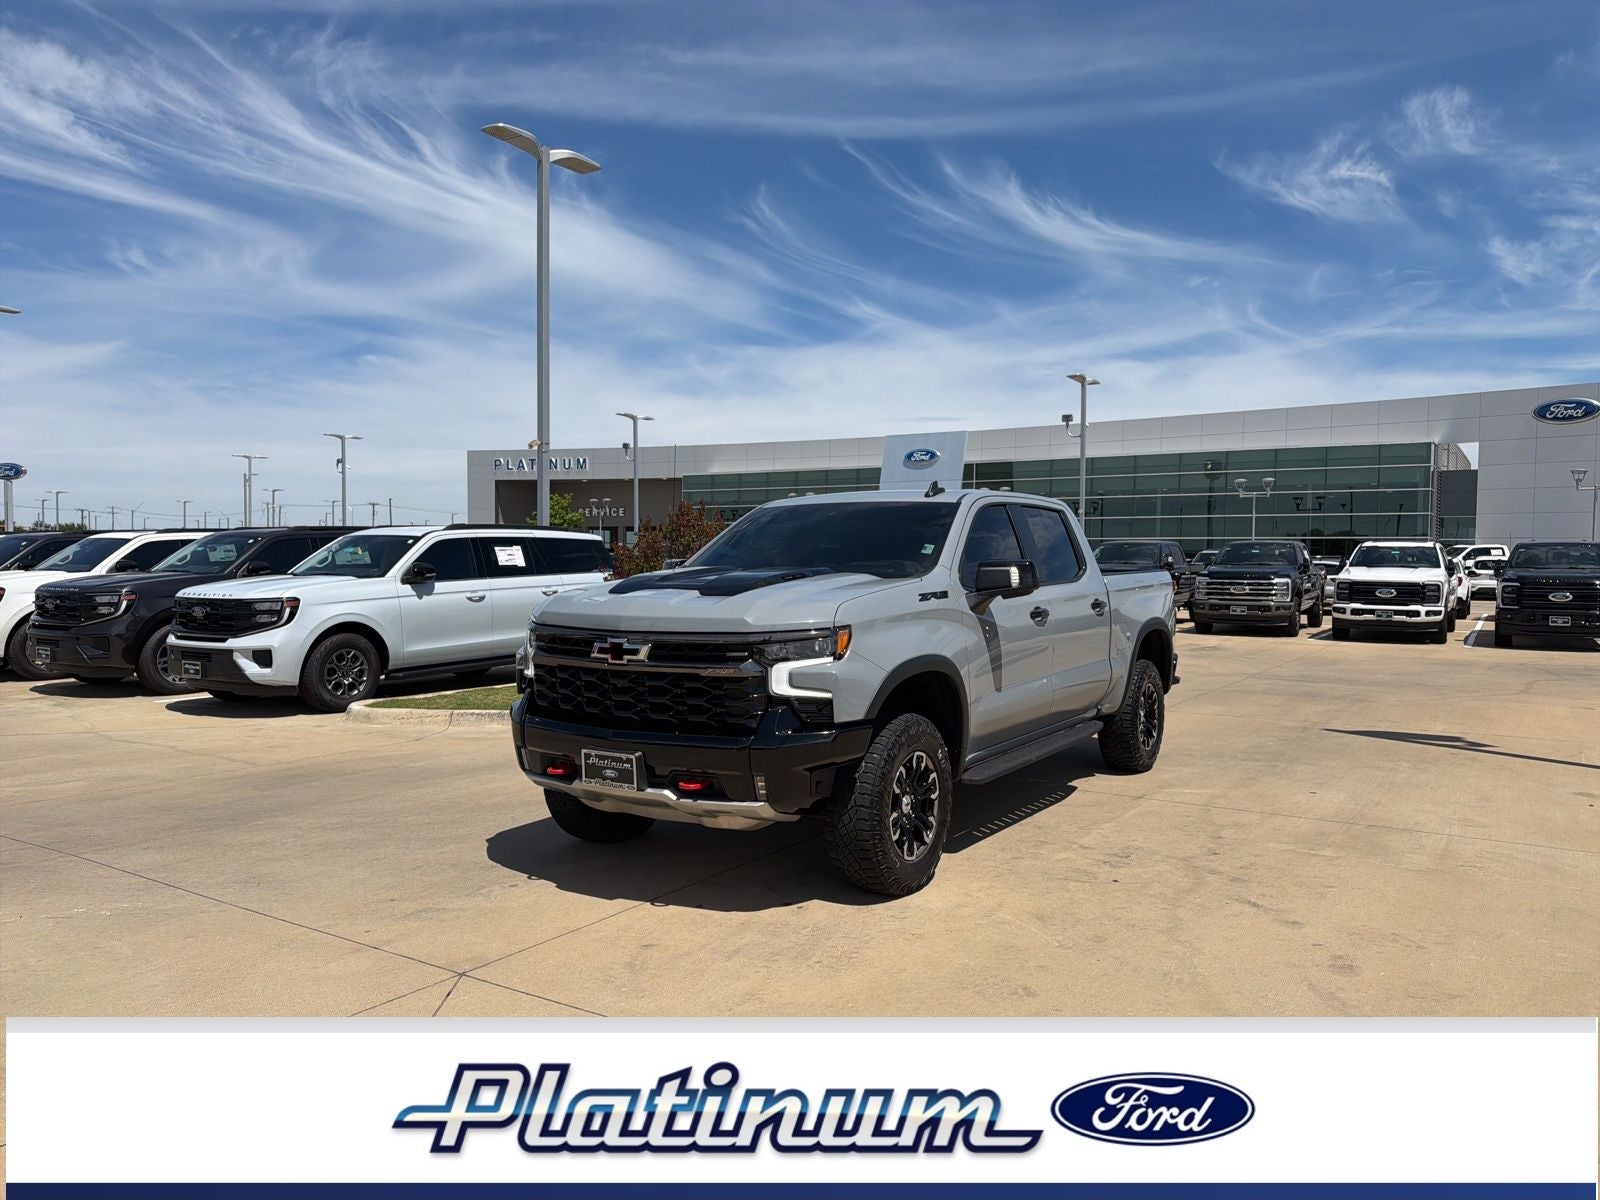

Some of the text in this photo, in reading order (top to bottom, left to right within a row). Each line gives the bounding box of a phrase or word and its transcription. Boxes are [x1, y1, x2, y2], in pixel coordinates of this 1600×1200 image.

[1546, 403, 1586, 418] Ford
[910, 451, 931, 461] Ford
[494, 458, 588, 471] PLATNUM
[586, 756, 633, 770] Platinum
